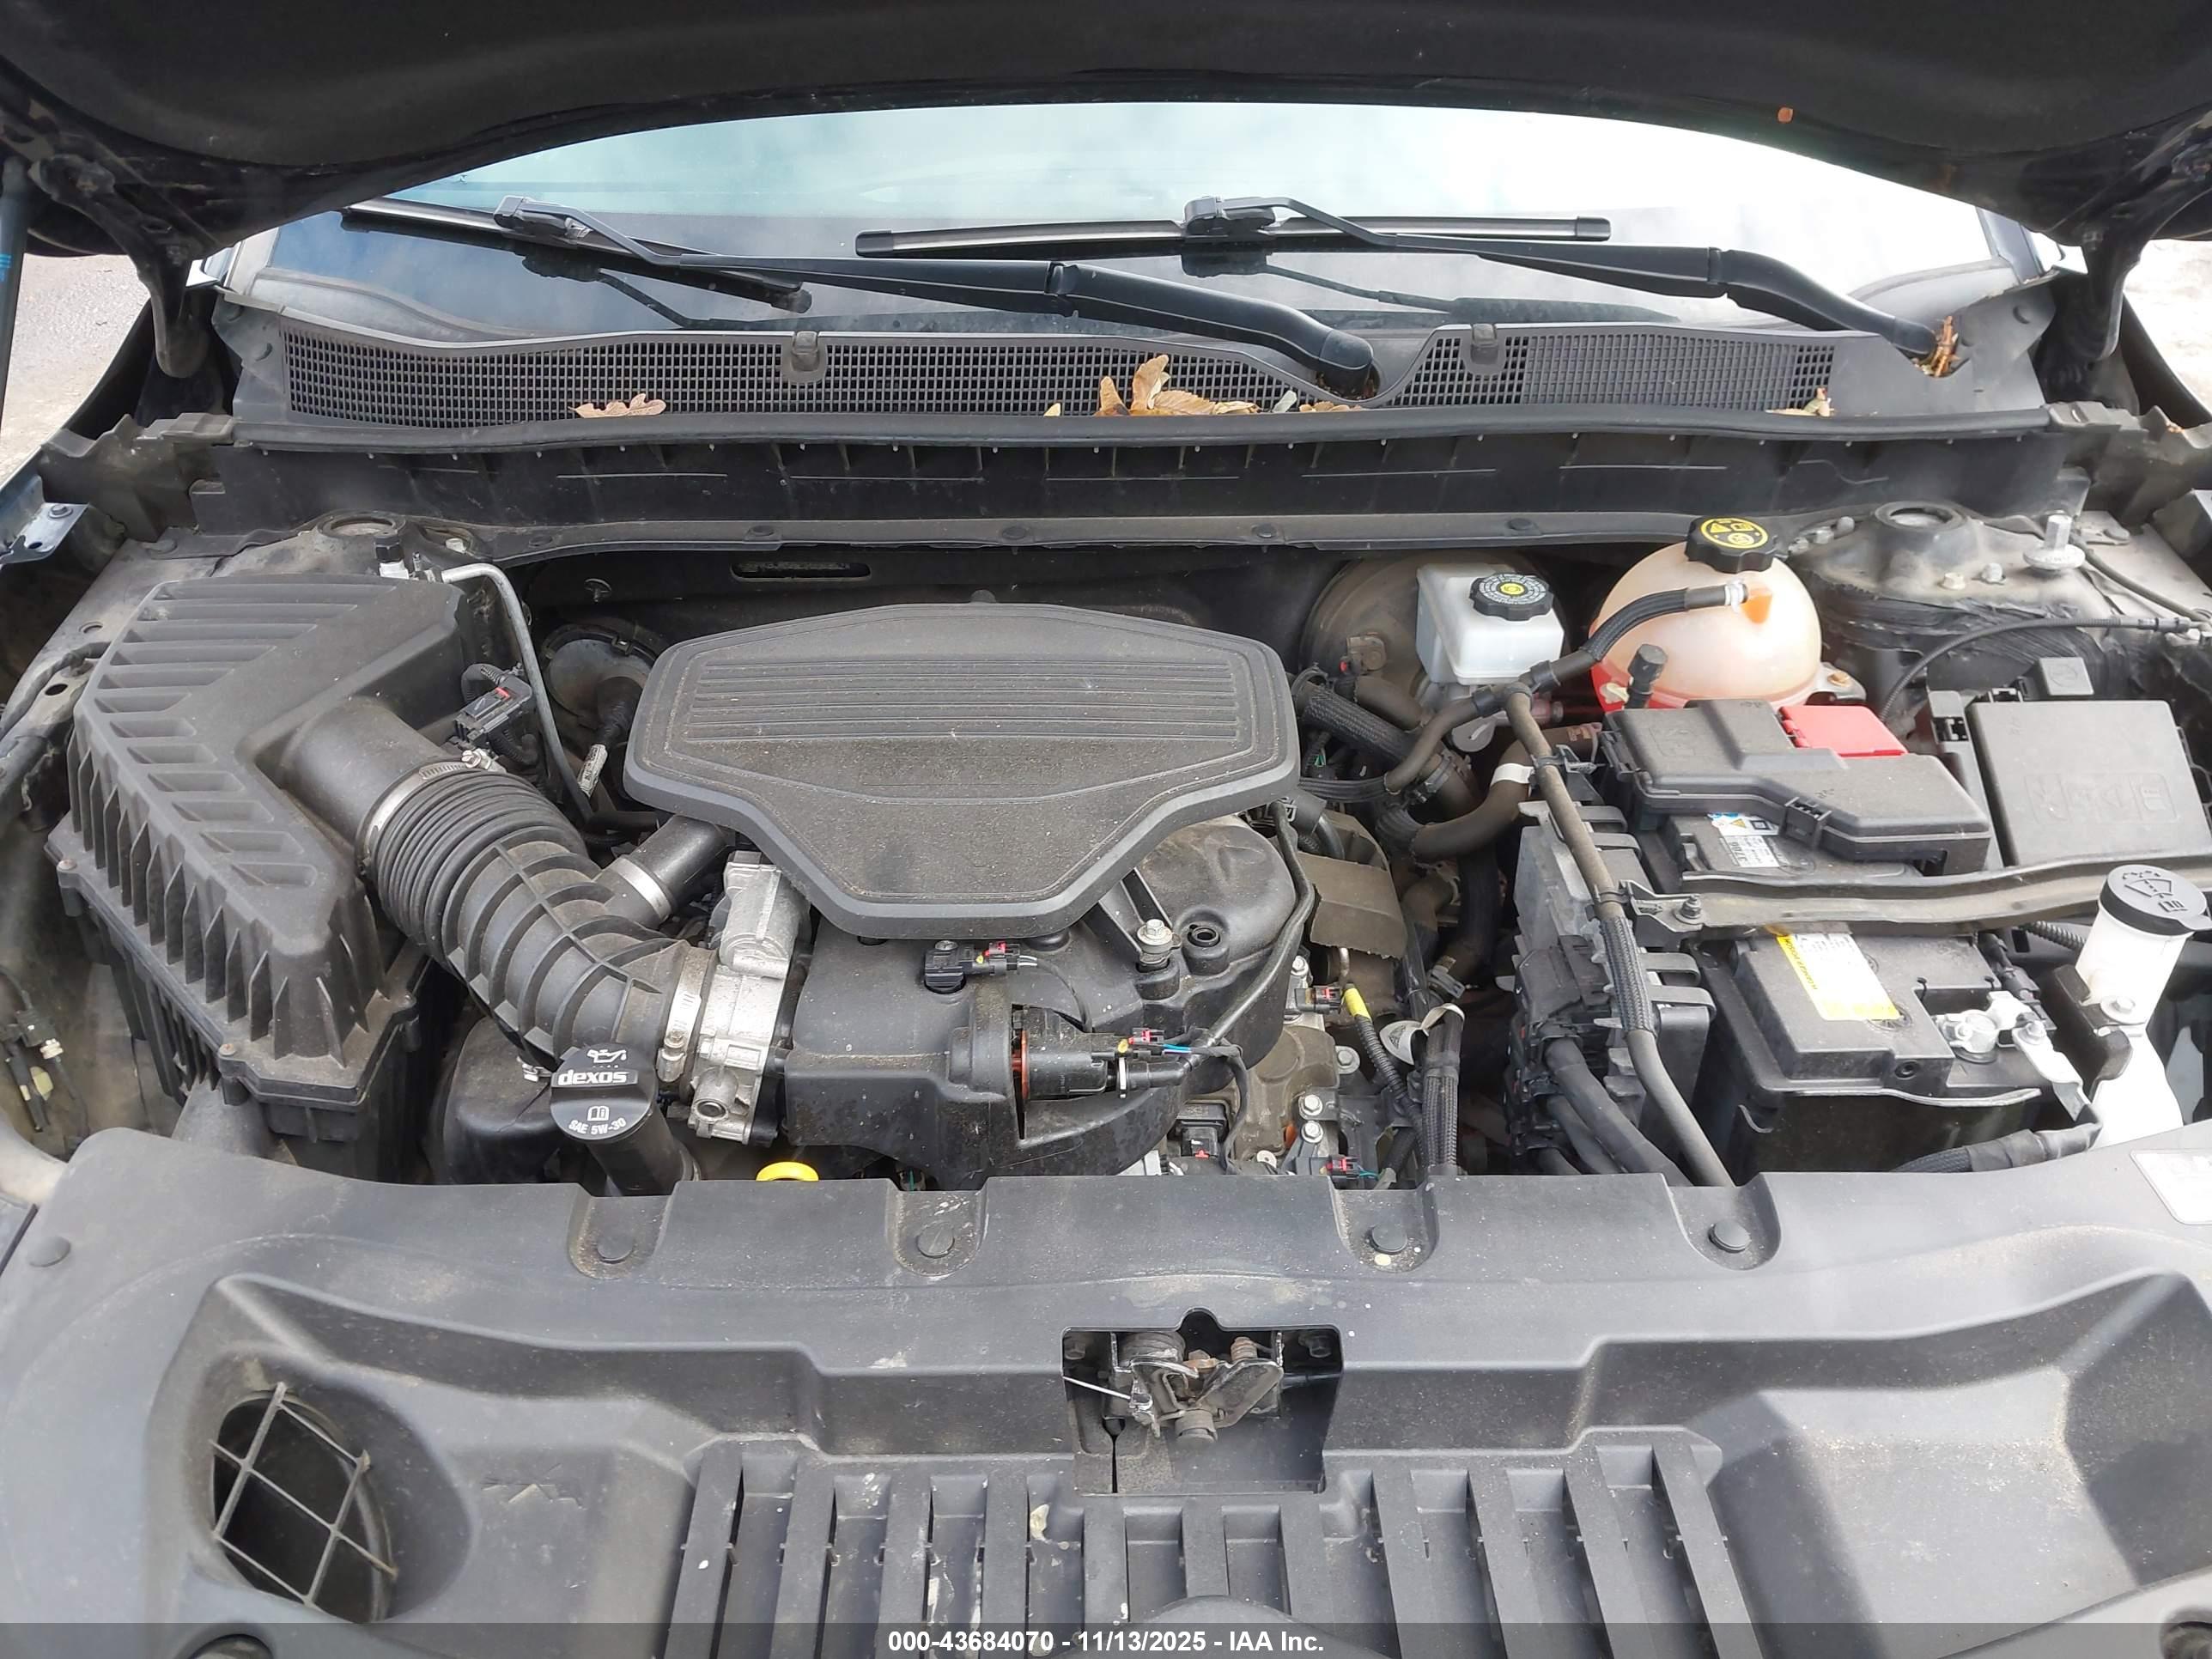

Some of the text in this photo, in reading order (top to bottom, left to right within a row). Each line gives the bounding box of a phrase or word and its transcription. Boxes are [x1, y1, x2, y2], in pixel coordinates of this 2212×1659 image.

[557, 1069, 630, 1085] dexos
[568, 1117, 627, 1135] SAE 5W-30
